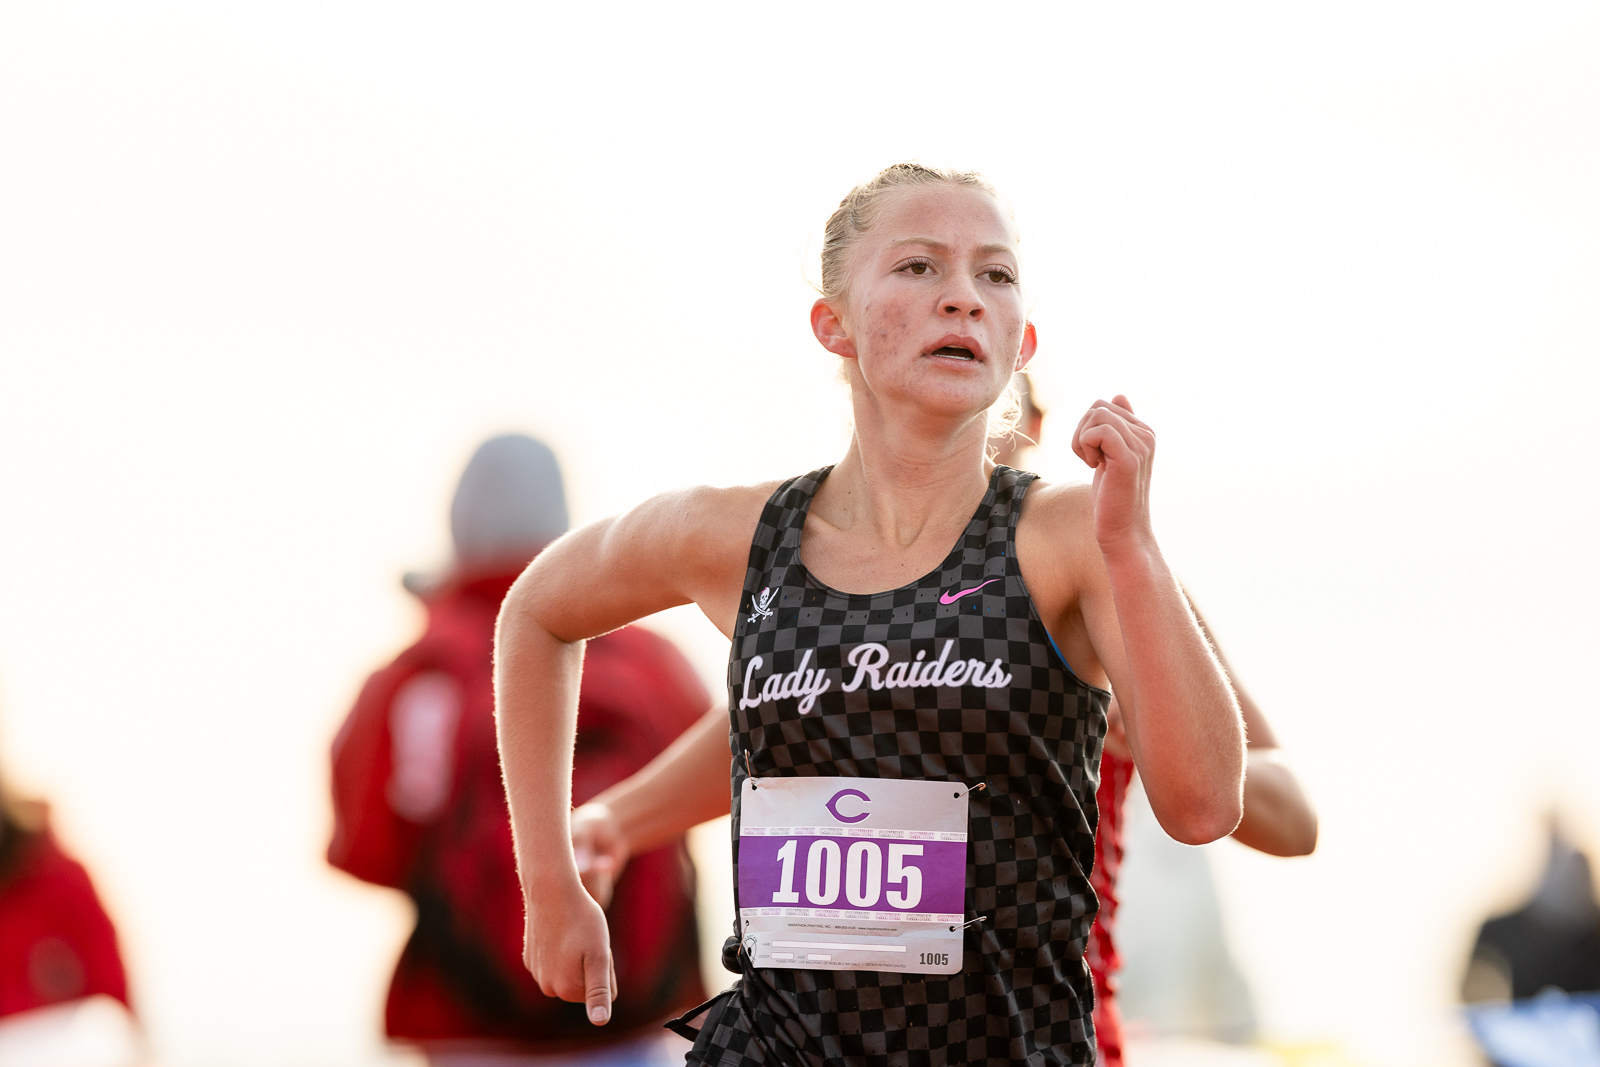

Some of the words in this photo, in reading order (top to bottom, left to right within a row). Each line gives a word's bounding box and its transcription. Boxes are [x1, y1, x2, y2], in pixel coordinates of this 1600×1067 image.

[739, 649, 831, 714] Lady
[841, 639, 1012, 692] Raiders
[825, 788, 872, 824] C
[772, 839, 924, 909] 1005
[919, 952, 949, 966] 1005
